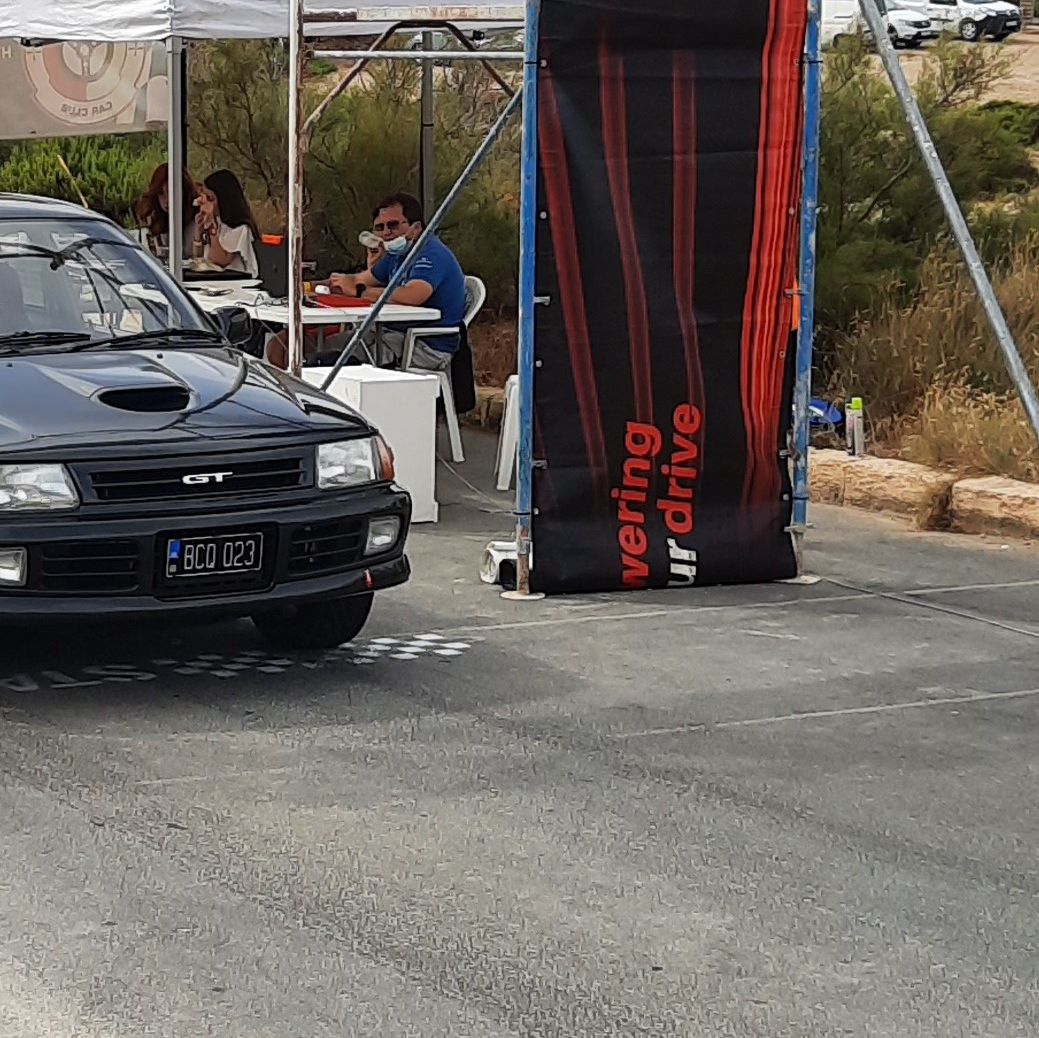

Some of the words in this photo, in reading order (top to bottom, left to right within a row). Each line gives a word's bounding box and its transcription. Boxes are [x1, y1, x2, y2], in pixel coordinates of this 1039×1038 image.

[181, 471, 233, 485] GT
[656, 403, 703, 534] drive
[222, 540, 256, 568] 023
